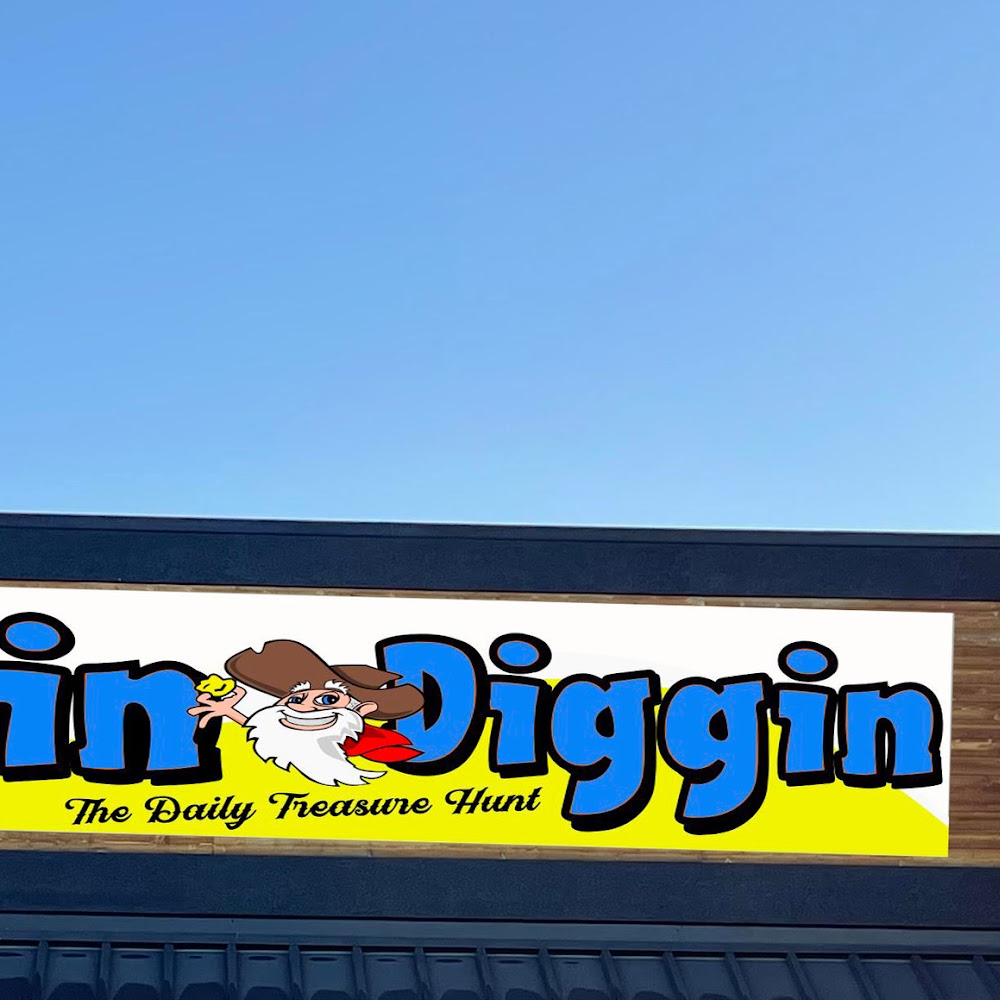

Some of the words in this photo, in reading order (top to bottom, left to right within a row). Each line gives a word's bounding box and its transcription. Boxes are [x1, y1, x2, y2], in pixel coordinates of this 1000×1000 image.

[375, 633, 943, 835] Diggin
[65, 797, 131, 825] The
[144, 795, 256, 831] Daily
[268, 791, 433, 820] Treasure
[444, 786, 544, 815] Hunt
